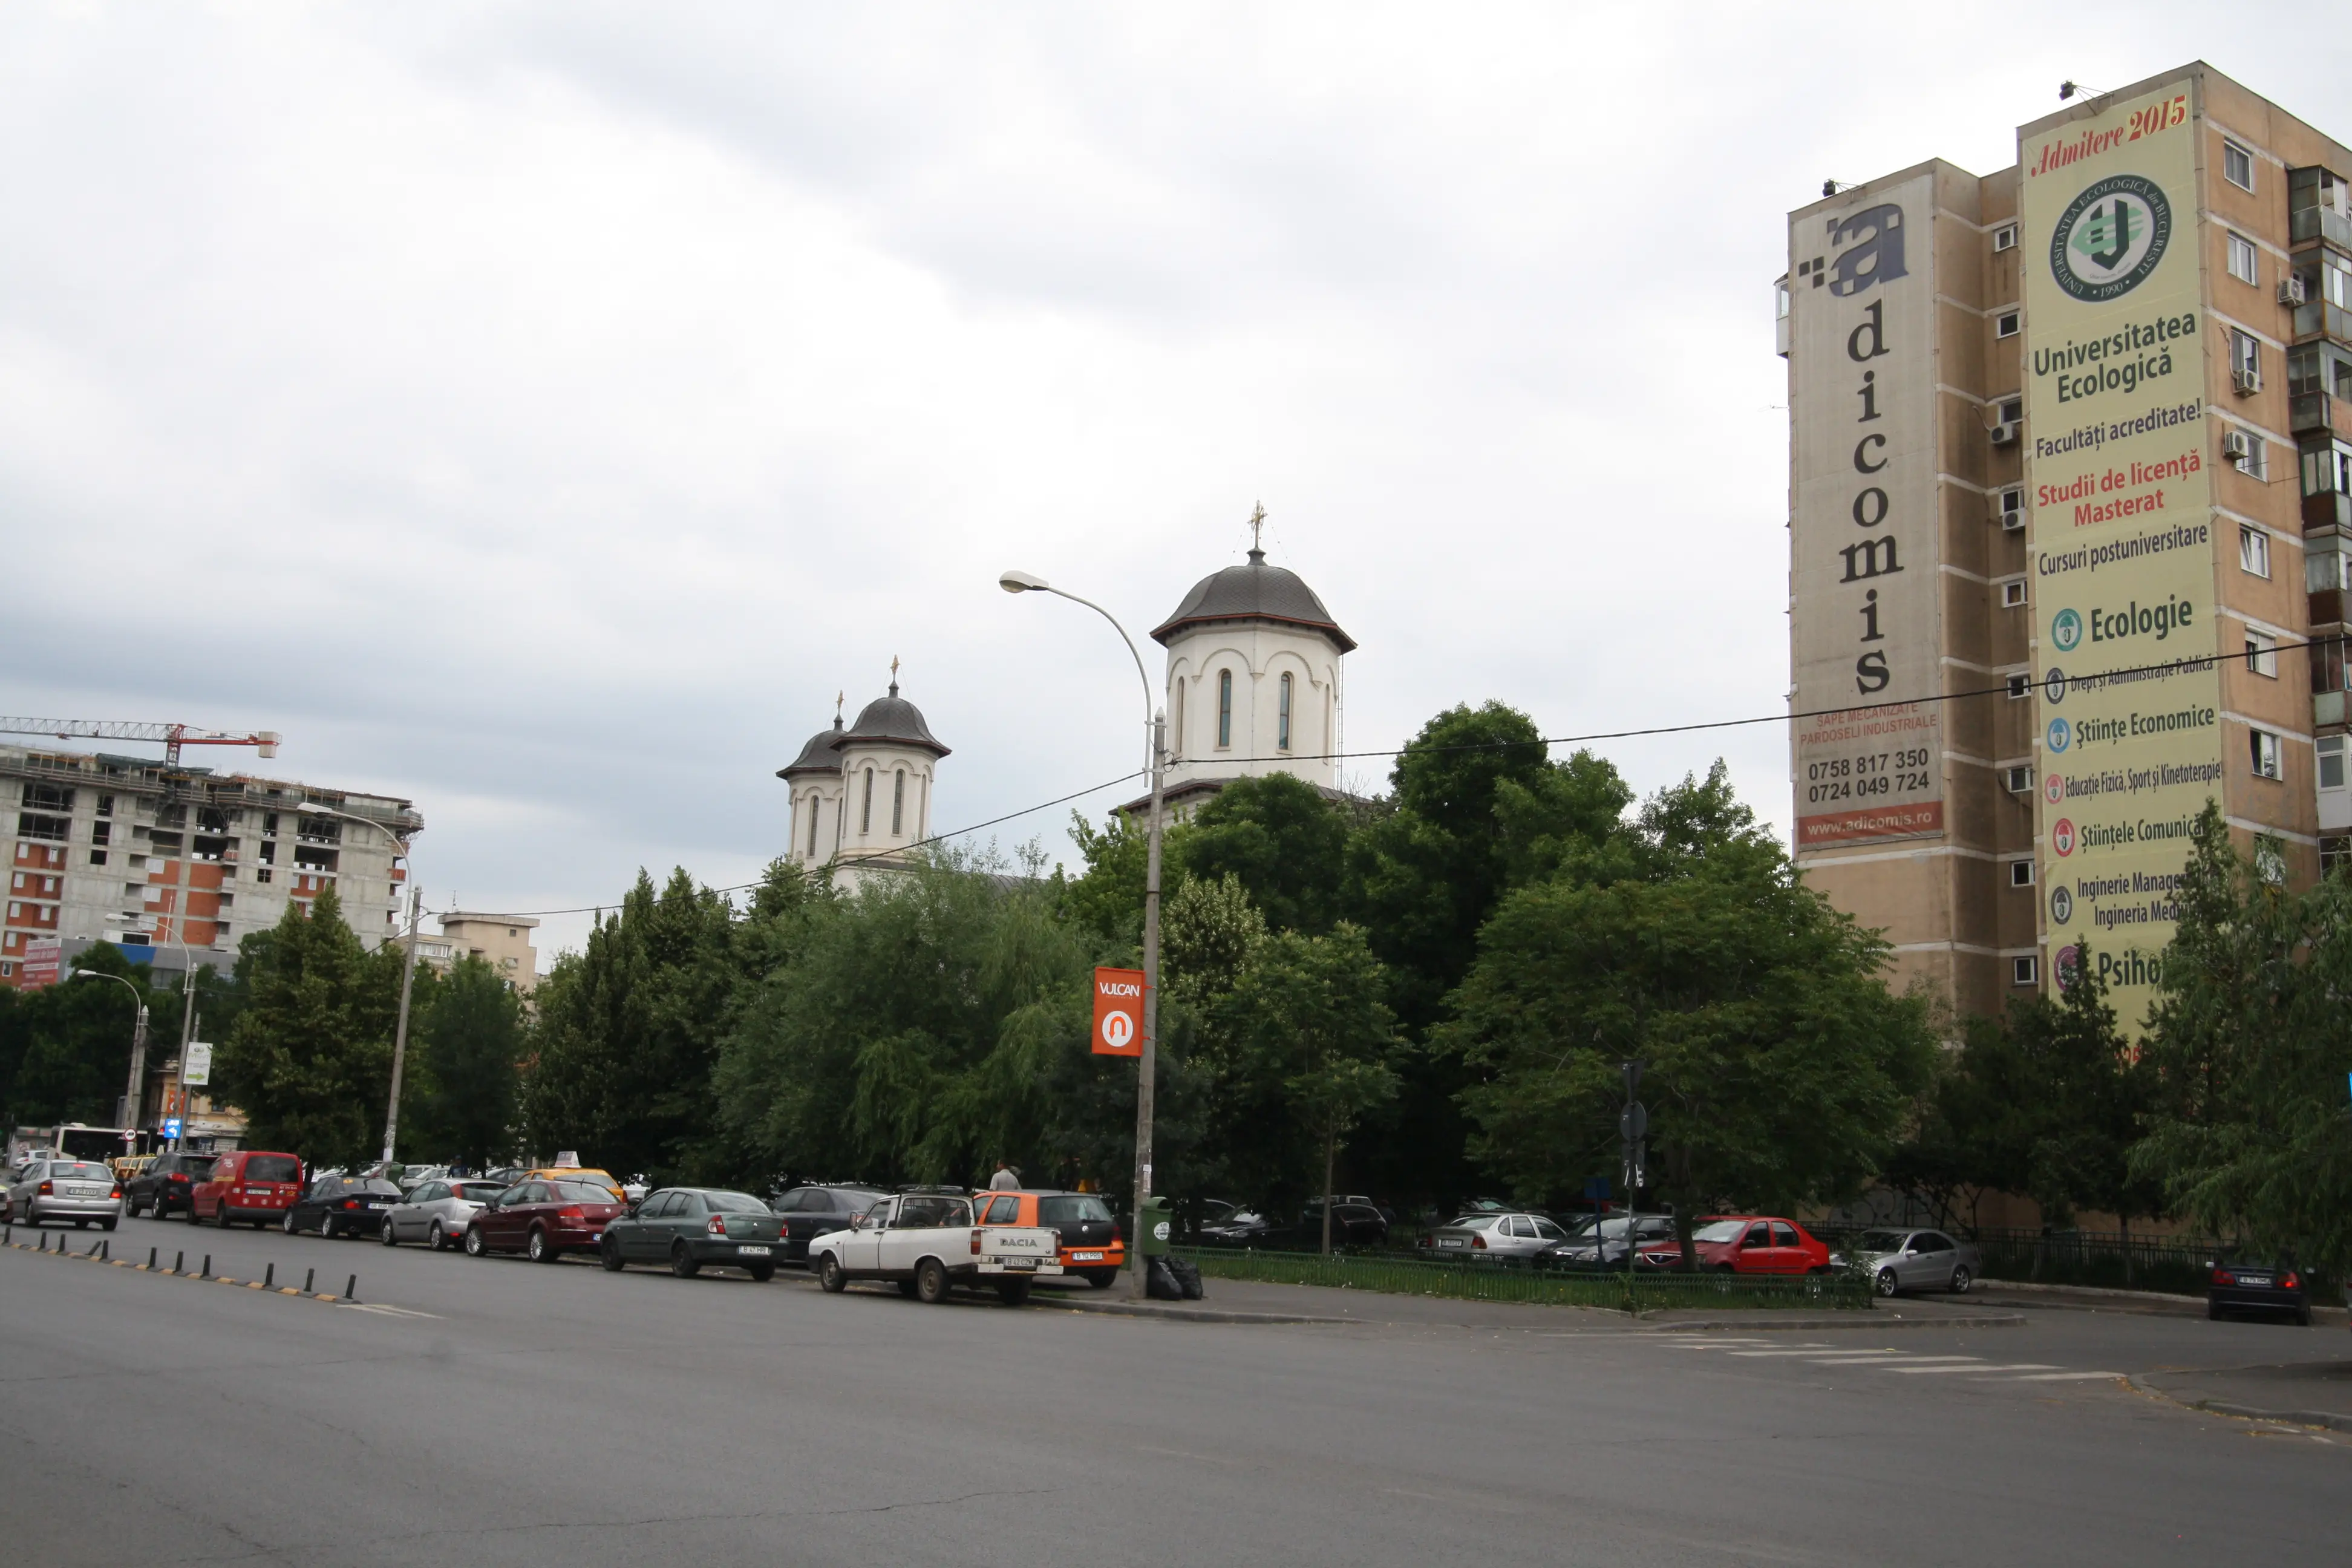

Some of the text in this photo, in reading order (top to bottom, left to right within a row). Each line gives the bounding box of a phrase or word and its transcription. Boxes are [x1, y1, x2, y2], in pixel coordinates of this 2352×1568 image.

[2031, 94, 2187, 177] Admitere 2015
[2054, 207, 2084, 295] UNIVERSITATEA
[2079, 179, 2149, 207] ECOLOGICĂ
[2147, 192, 2160, 205] din
[2100, 282, 2123, 297] 1990
[2034, 312, 2196, 376] Universitatea
[2057, 347, 2172, 403] Ecologică
[2036, 397, 2202, 459] Facultăți acreditate!
[1827, 203, 1909, 694] adicomis
[2039, 448, 2201, 507] Studii de licență
[2074, 489, 2164, 527] Masterat
[2039, 524, 2207, 576] Cursuri postuniversitare
[2091, 593, 2192, 642] Ecologie
[1800, 714, 1937, 746] PARDOSELI INDUSTRIALE
[1847, 702, 1918, 722] MECANIZATE
[2131, 704, 2215, 736] Economice
[1809, 748, 1929, 781] 0758 817 350
[2065, 773, 2099, 801] Educație
[2128, 768, 2152, 795] Sport
[2152, 765, 2159, 794] și
[2160, 757, 2221, 786] Kinetoterapie
[1809, 771, 1929, 803] 0724 049 724
[1808, 811, 1932, 835] www.adicomis.ro
[2081, 814, 2204, 853] Științele Comunică
[2077, 873, 2129, 902] Inginerie
[2095, 902, 2148, 930] Ingineria
[1099, 982, 1140, 997] VULCAN
[999, 1238, 1037, 1247] DACIA
